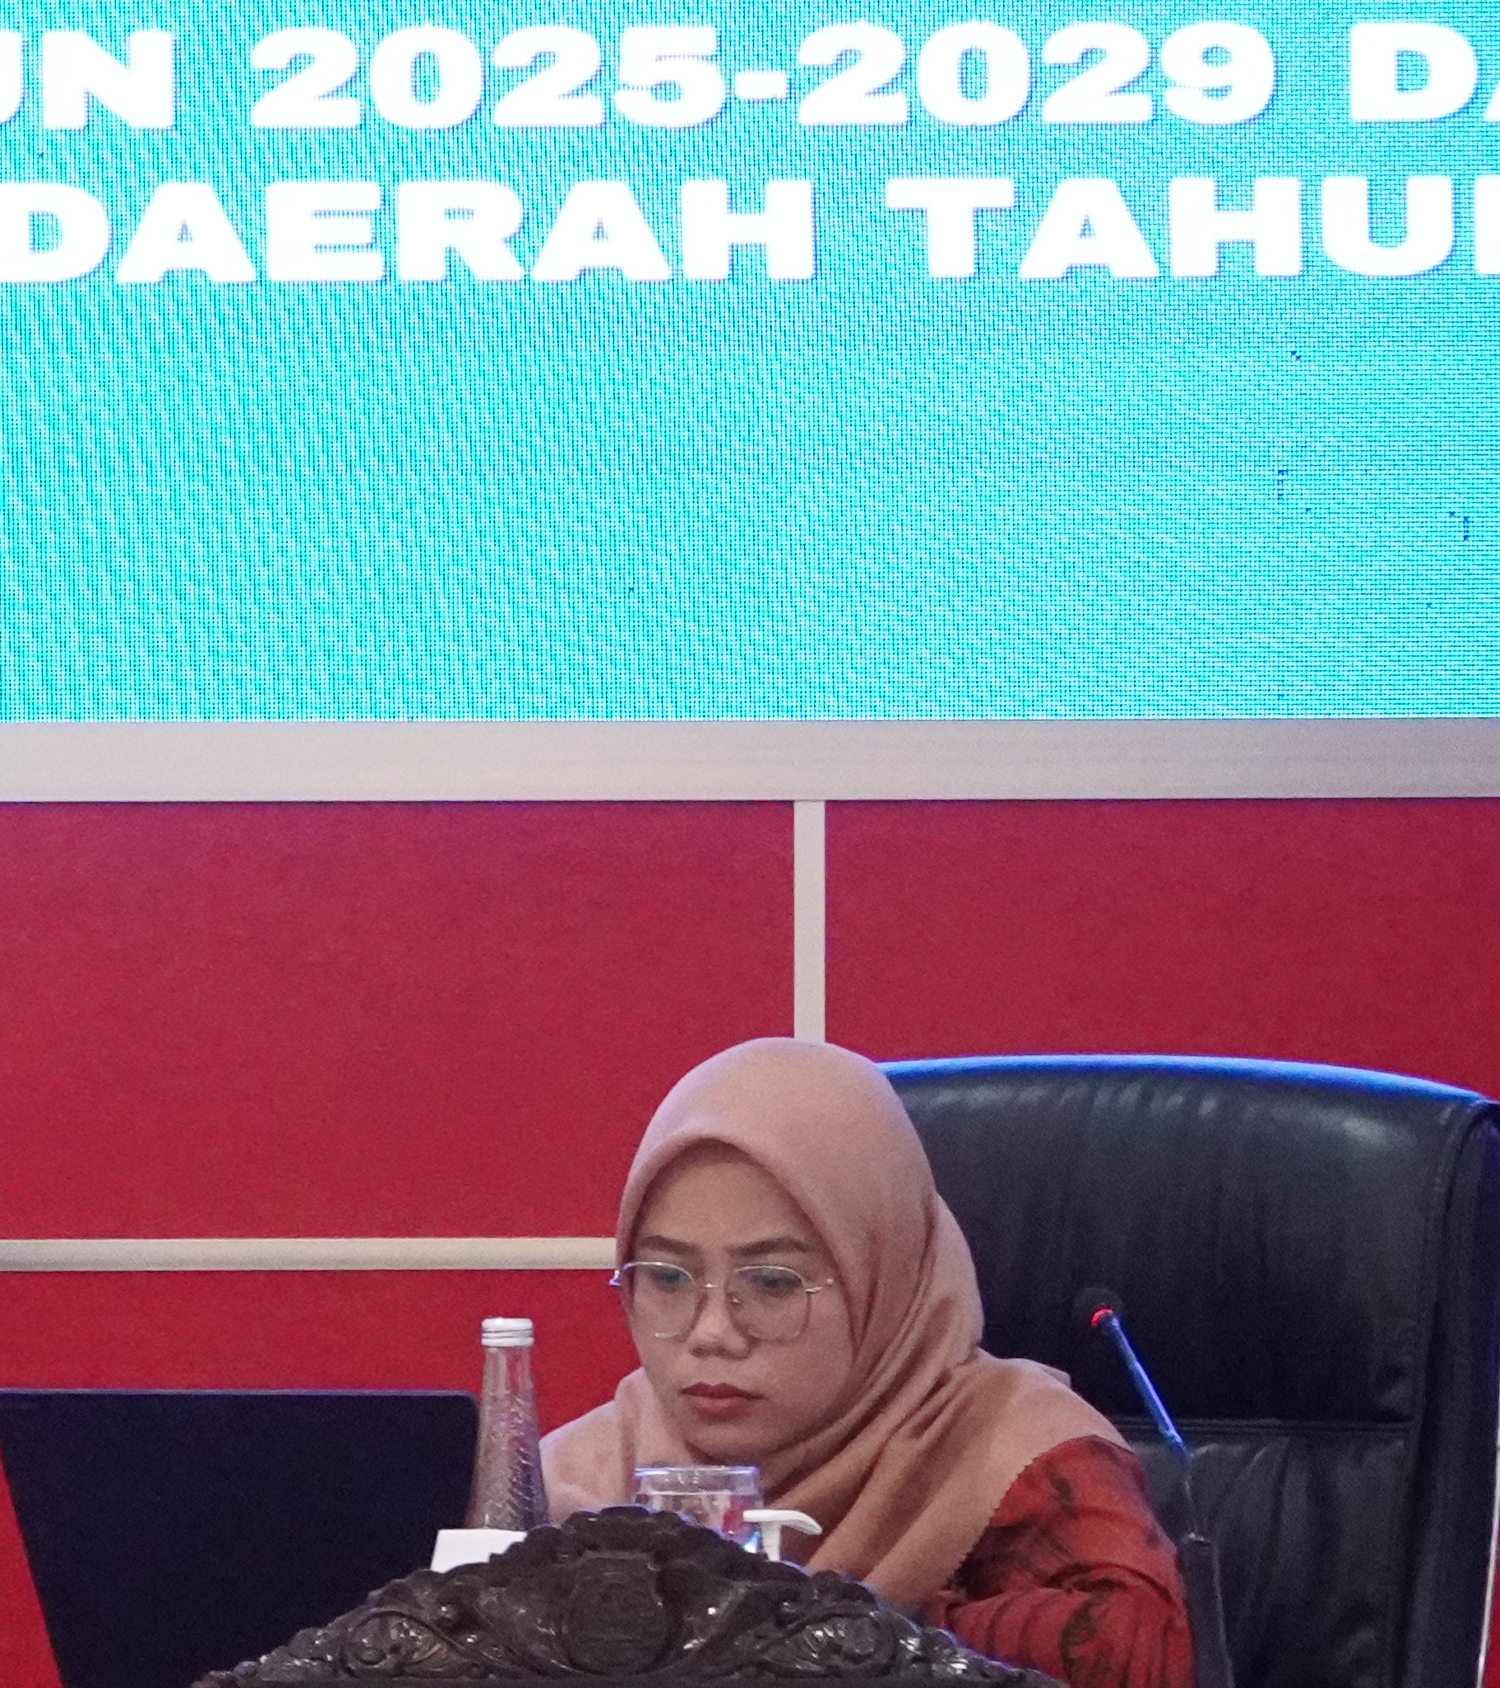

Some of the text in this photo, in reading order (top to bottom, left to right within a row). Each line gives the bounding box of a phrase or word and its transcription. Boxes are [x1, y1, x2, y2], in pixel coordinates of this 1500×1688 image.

[251, 20, 1275, 130] 2025-2029
[1349, 22, 1500, 122] D
[885, 175, 1500, 280] TAHU
